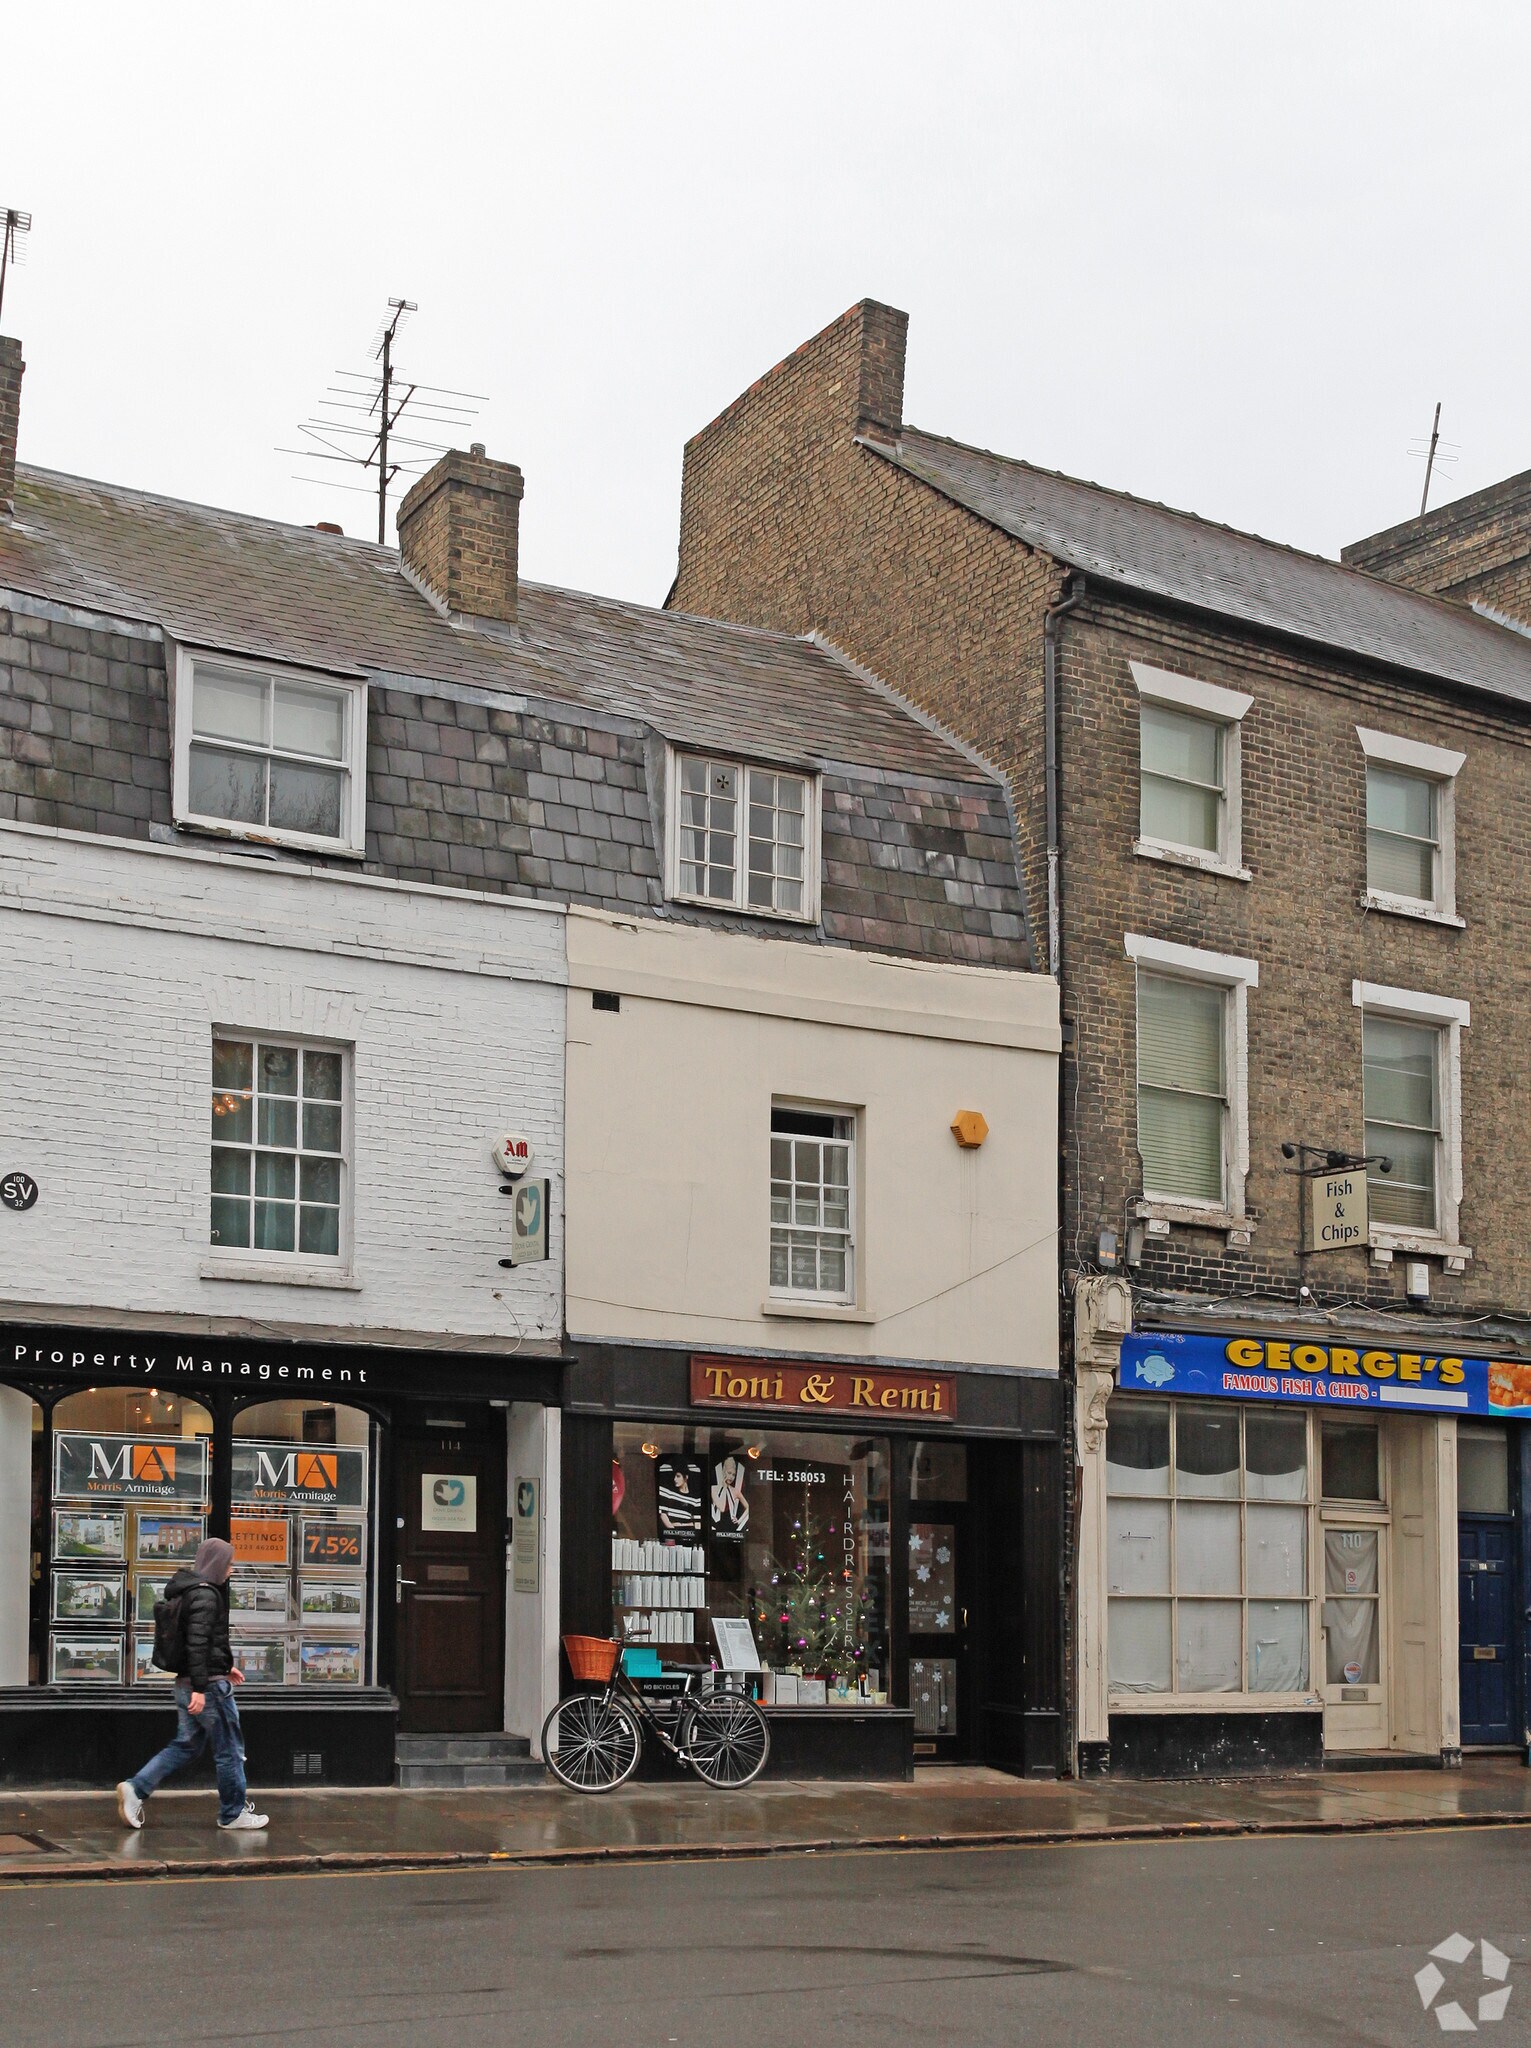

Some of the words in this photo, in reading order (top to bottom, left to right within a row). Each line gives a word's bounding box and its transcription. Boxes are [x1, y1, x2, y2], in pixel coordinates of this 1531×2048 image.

[13, 1175, 25, 1183] 100
[1326, 1179, 1353, 1198] Fish
[3, 1182, 33, 1200] SV
[14, 1199, 24, 1207] 32
[1334, 1202, 1345, 1218] &
[1321, 1223, 1359, 1243] Chips
[15, 1345, 156, 1373] Property
[175, 1355, 367, 1383] Management
[1225, 1339, 1465, 1385] GEORGE'S
[705, 1367, 785, 1400] Toni
[799, 1374, 835, 1404] &
[848, 1377, 943, 1412] Remi
[1222, 1373, 1278, 1393] FAMOUS
[1281, 1377, 1312, 1396] FISH
[1314, 1380, 1326, 1397] &
[1328, 1381, 1369, 1400] CHIPS
[441, 1440, 460, 1450] 114
[87, 1443, 175, 1481] MA
[254, 1451, 337, 1489] MA
[757, 1469, 784, 1481] TEL:
[787, 1471, 826, 1484] 358053
[87, 1482, 121, 1491] Morris
[125, 1483, 175, 1495] Armitage
[254, 1489, 287, 1498] Morris
[289, 1490, 337, 1502] Armitage
[306, 1535, 359, 1556] 7.5%
[1341, 1533, 1362, 1549] 110
[843, 1474, 855, 1665] HAIRDRESSERS
